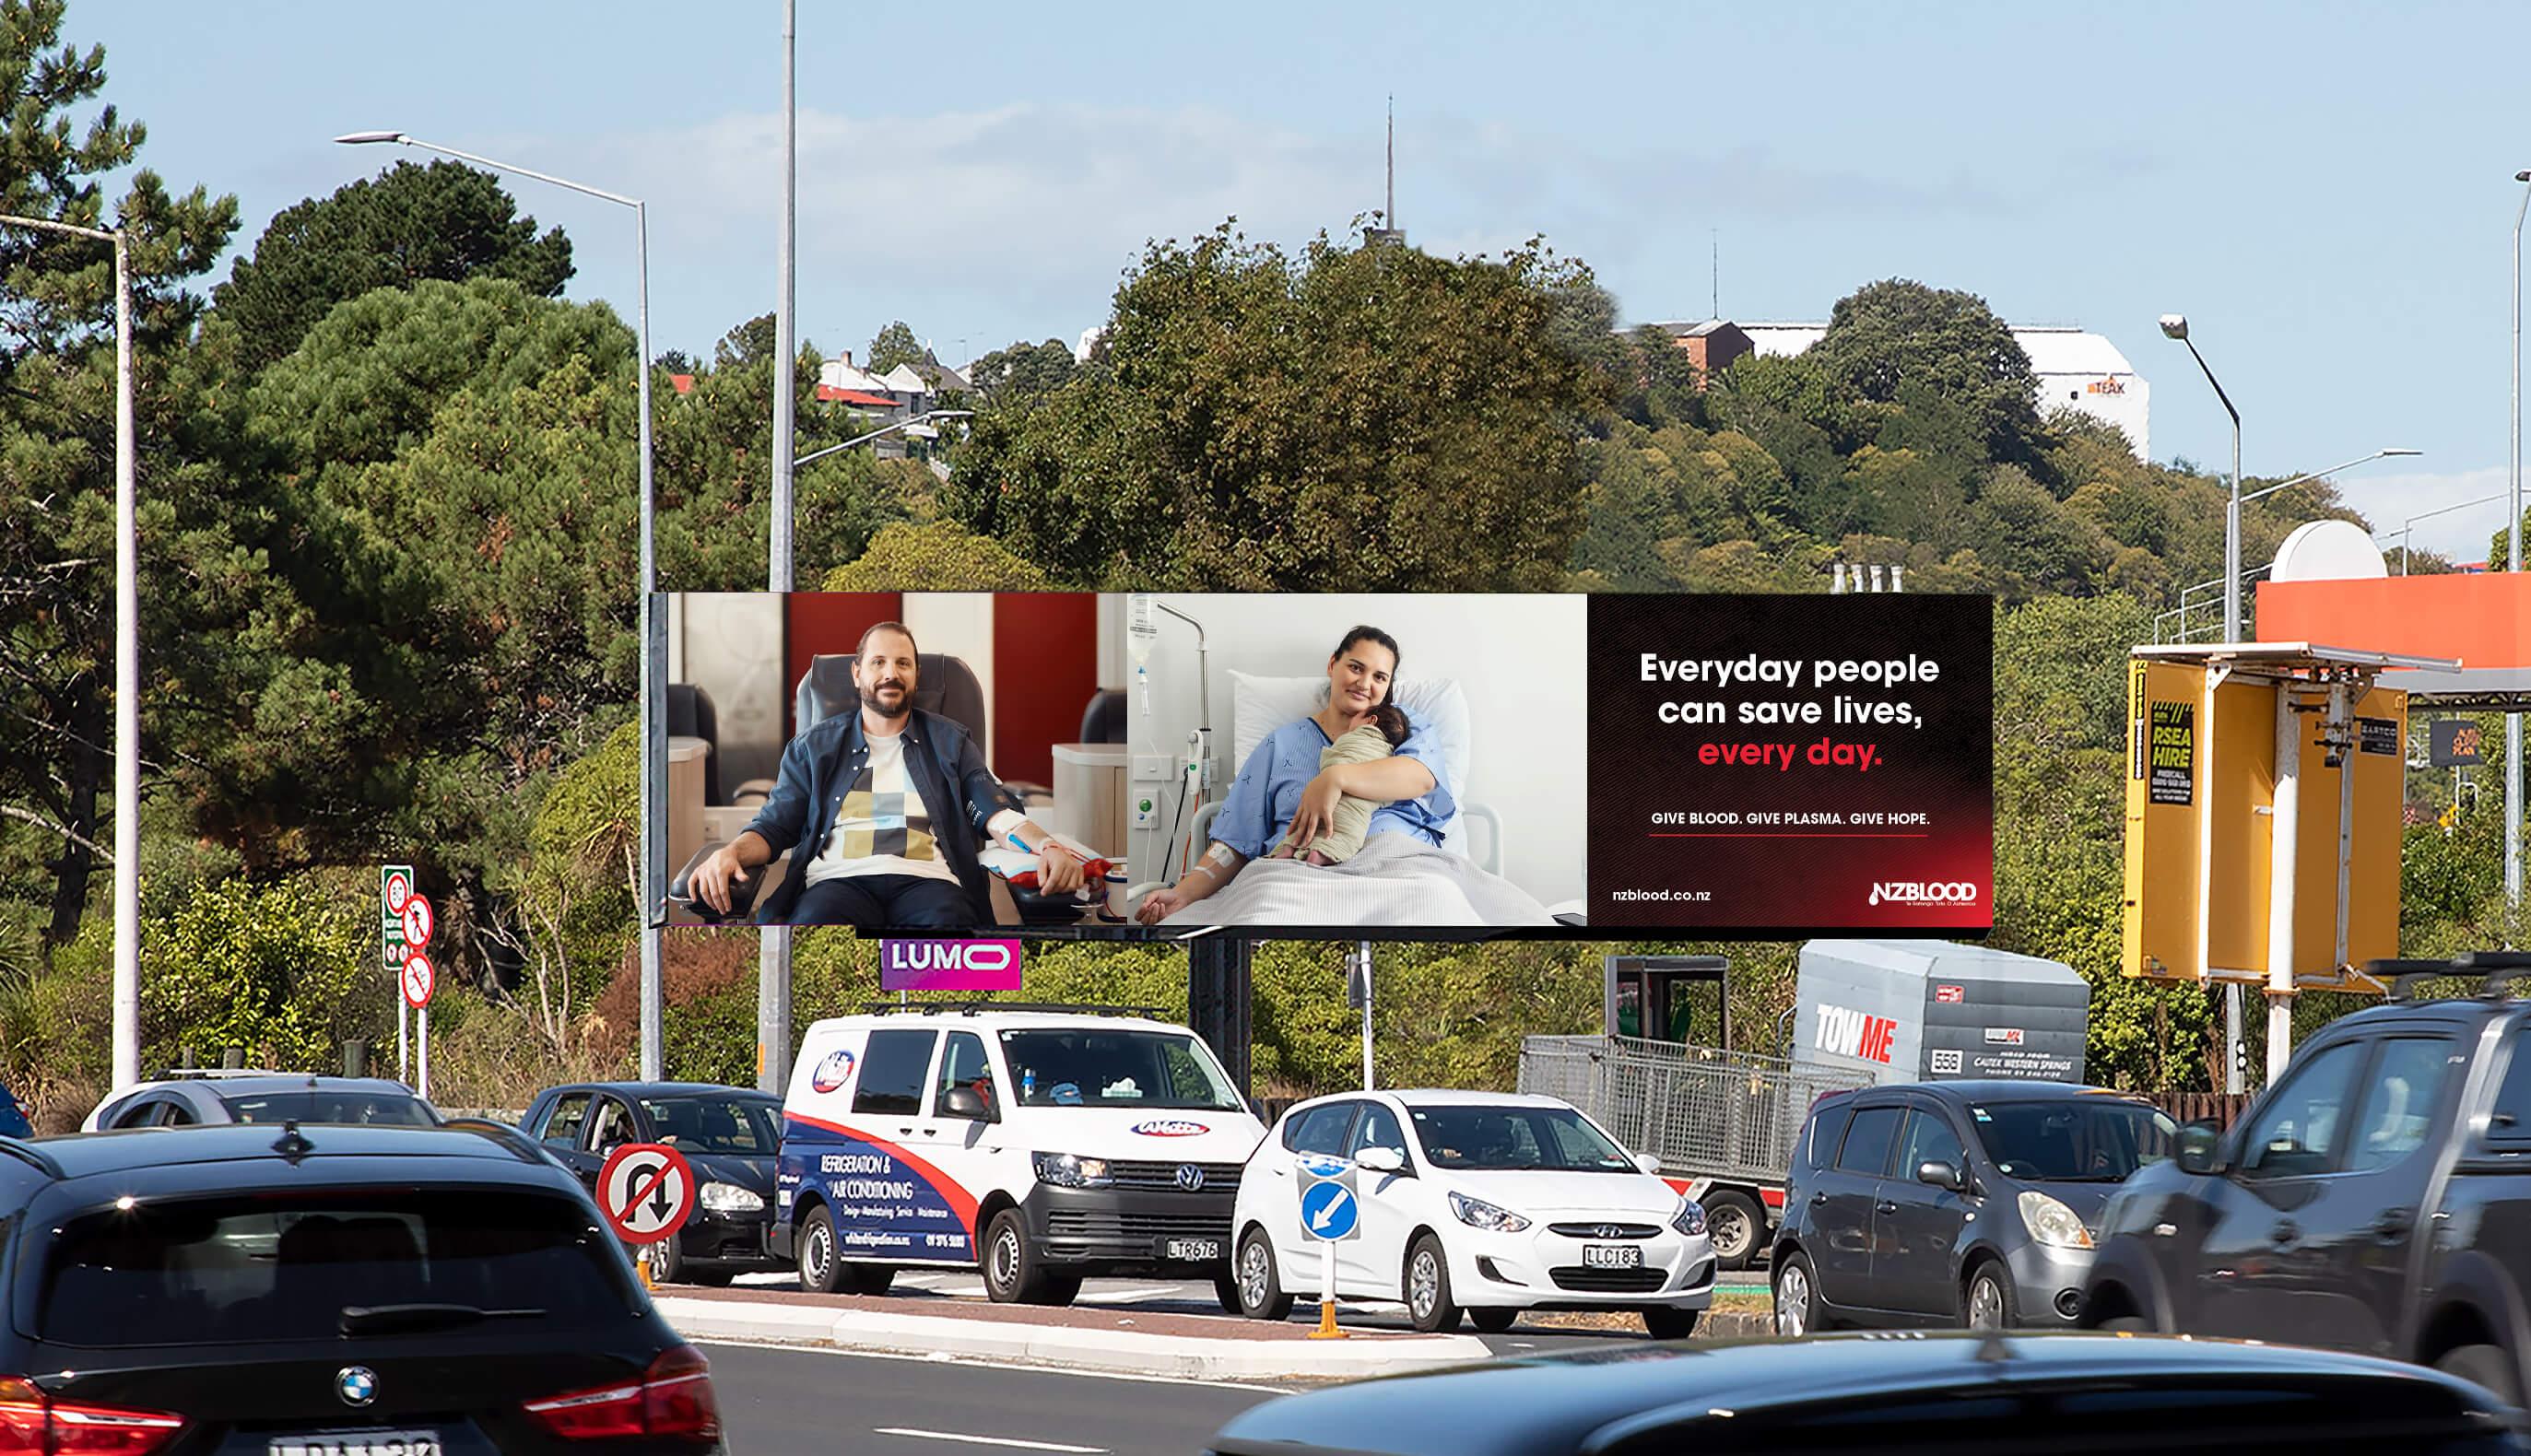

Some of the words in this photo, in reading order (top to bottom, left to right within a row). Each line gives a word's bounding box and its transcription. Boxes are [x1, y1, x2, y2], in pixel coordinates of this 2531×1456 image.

[1641, 653, 1802, 687] Everyday
[1814, 653, 1940, 687] people
[1658, 701, 1725, 723] can
[1738, 701, 1822, 723] save
[1833, 696, 1923, 729] lives,
[2153, 726, 2192, 746] RSEA
[1698, 743, 1796, 771] every
[1807, 737, 1883, 771] day.
[2152, 746, 2192, 768] HIRE
[1651, 812, 1686, 825] GIVE
[1689, 812, 1743, 825] BLOOD.
[1747, 812, 1781, 825] GIVE
[1784, 812, 1846, 825] PLASMA.
[1850, 812, 1884, 825] GIVE
[1888, 812, 1931, 826] HOPE.
[1612, 888, 1712, 901] nzblood.co.nz
[1873, 882, 1977, 901] NZBLOOD
[891, 943, 1011, 970] LUMO
[2040, 1060, 2072, 1072] SPRINGS
[1168, 1241, 1218, 1259] LTR676
[1587, 1249, 1641, 1264] LLC183
